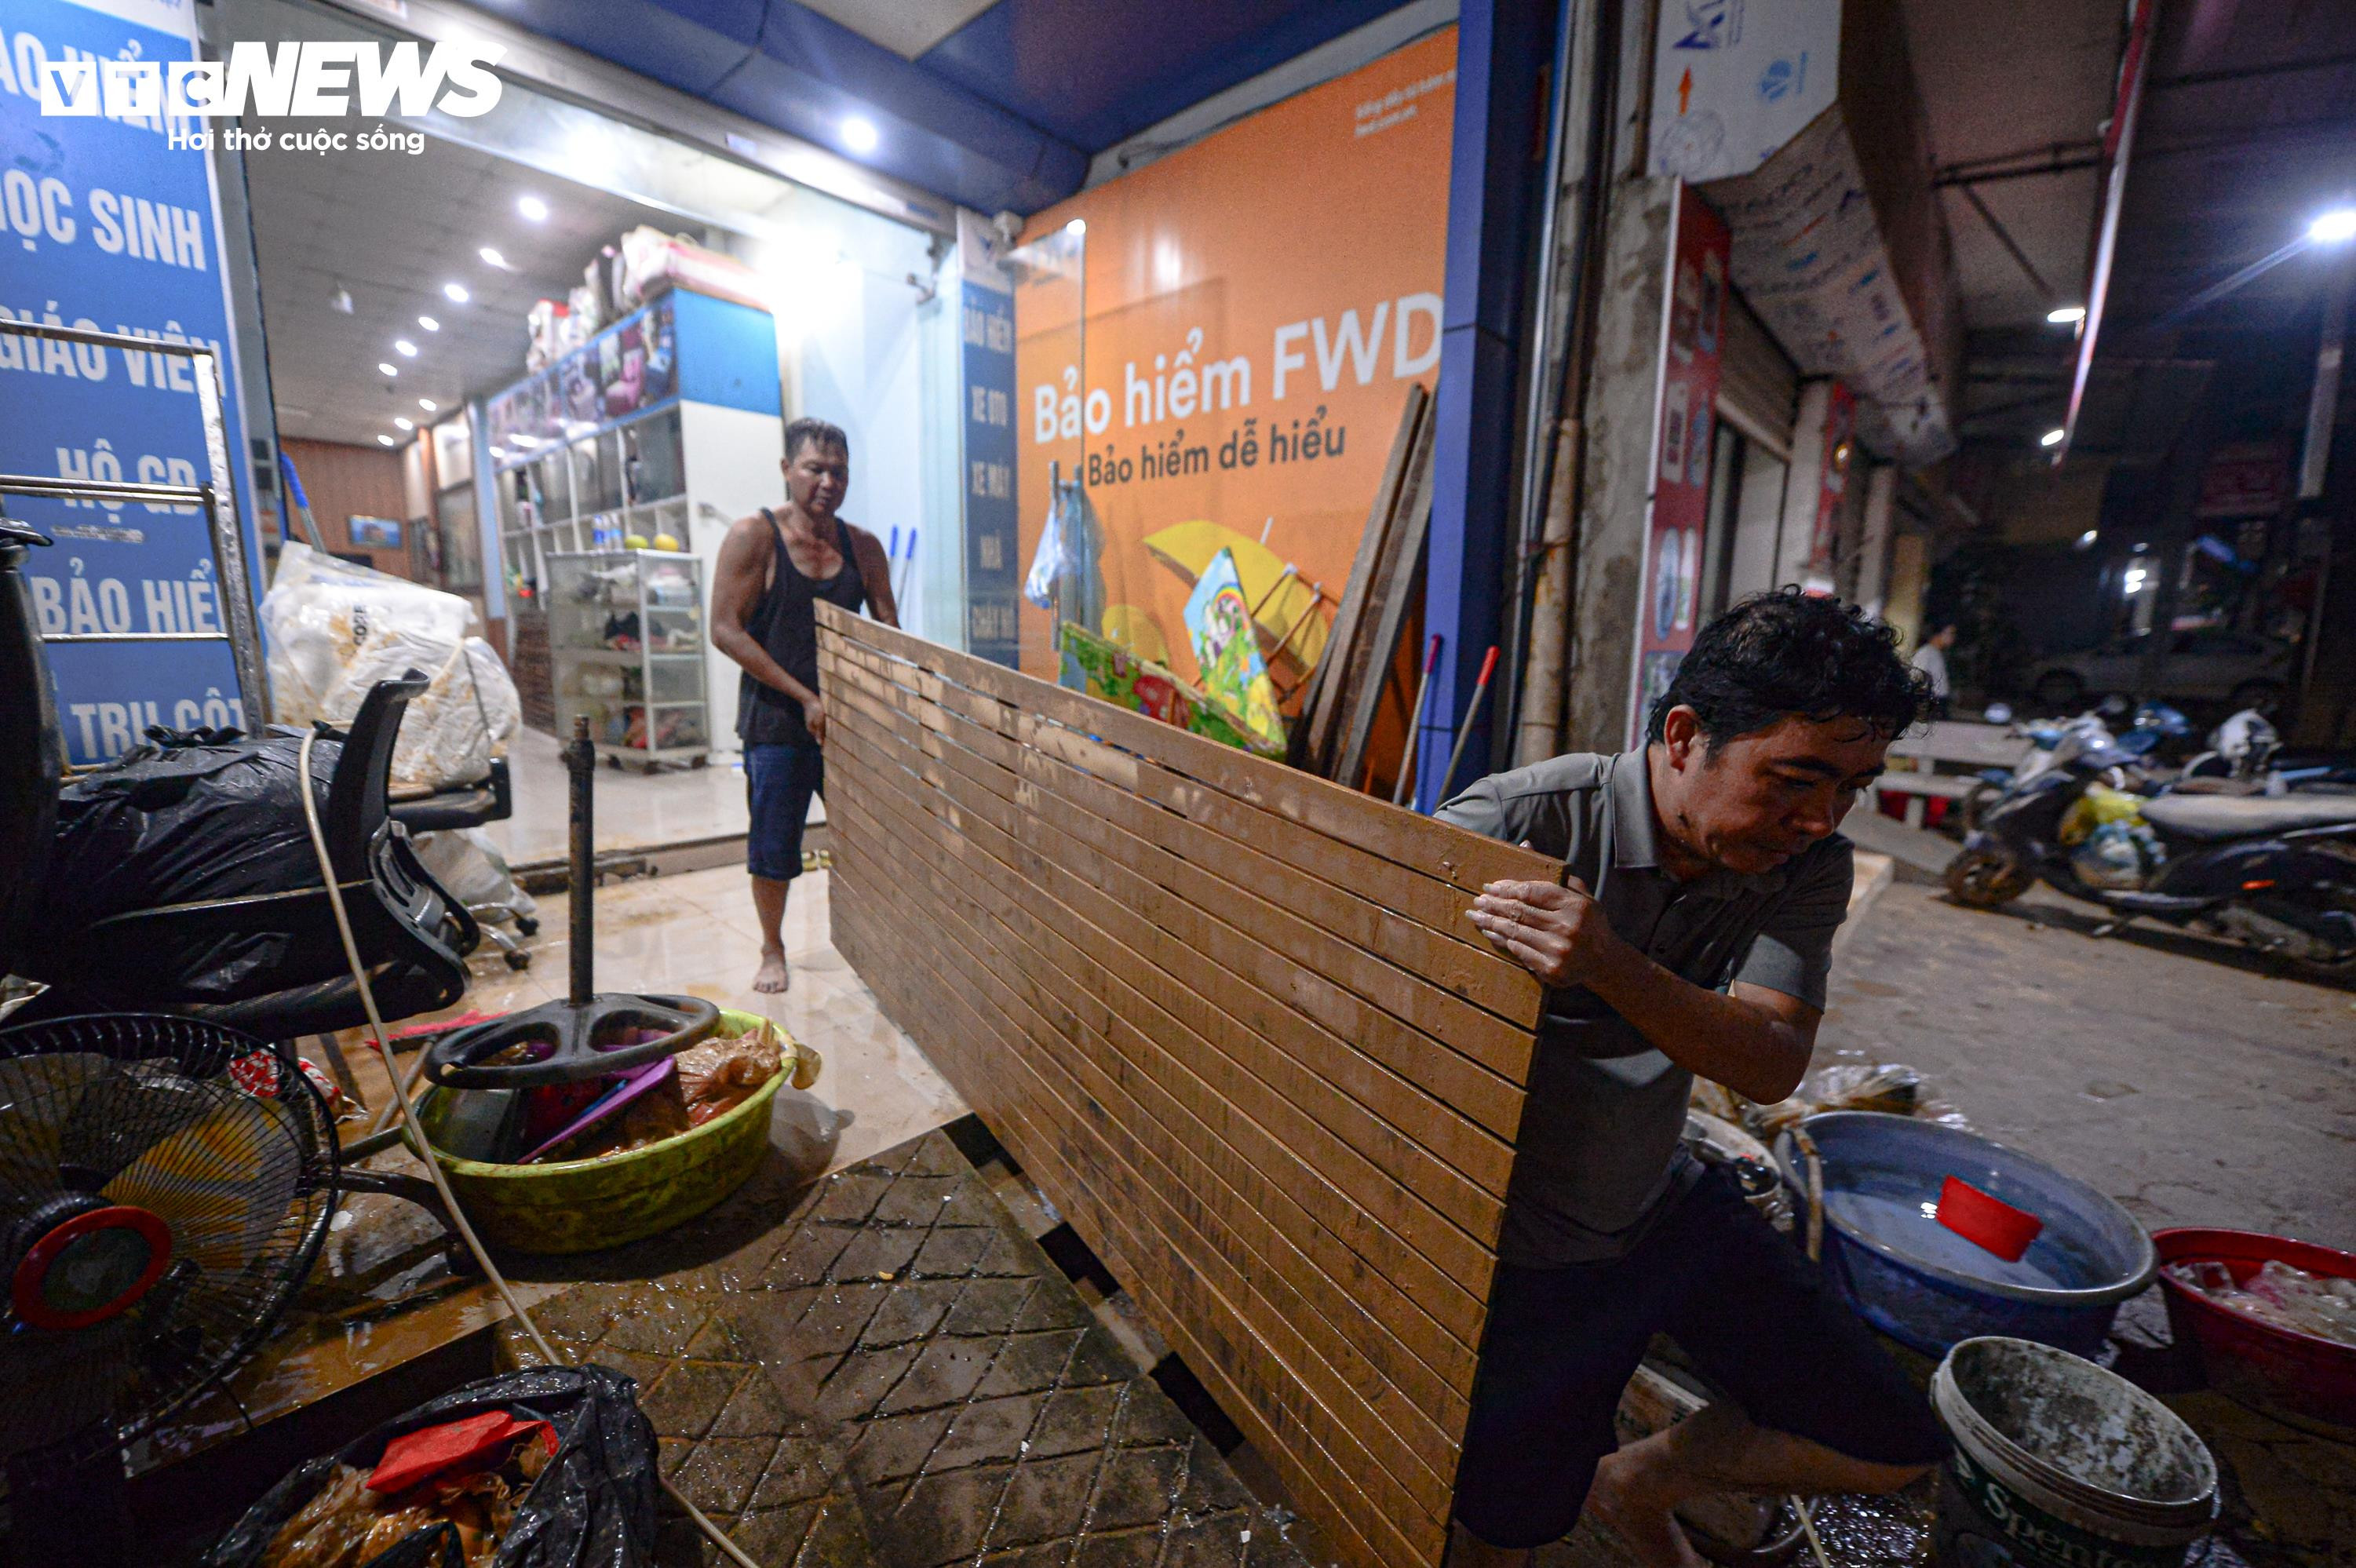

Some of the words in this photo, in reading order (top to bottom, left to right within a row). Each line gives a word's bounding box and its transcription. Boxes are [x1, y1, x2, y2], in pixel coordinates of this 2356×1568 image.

[0, 168, 76, 252] ỌC
[89, 188, 206, 272] SINH
[1034, 364, 1111, 444] Bảo
[1125, 326, 1252, 428] hiểm
[1272, 291, 1444, 400] FWD
[56, 438, 126, 523] HỘ
[1088, 444, 1133, 487] Bảo
[1140, 428, 1209, 480] hiểm
[1218, 417, 1259, 472] dễ
[1269, 405, 1346, 466] hiểu
[31, 556, 132, 633] BẢO
[141, 558, 227, 633] HIỂ
